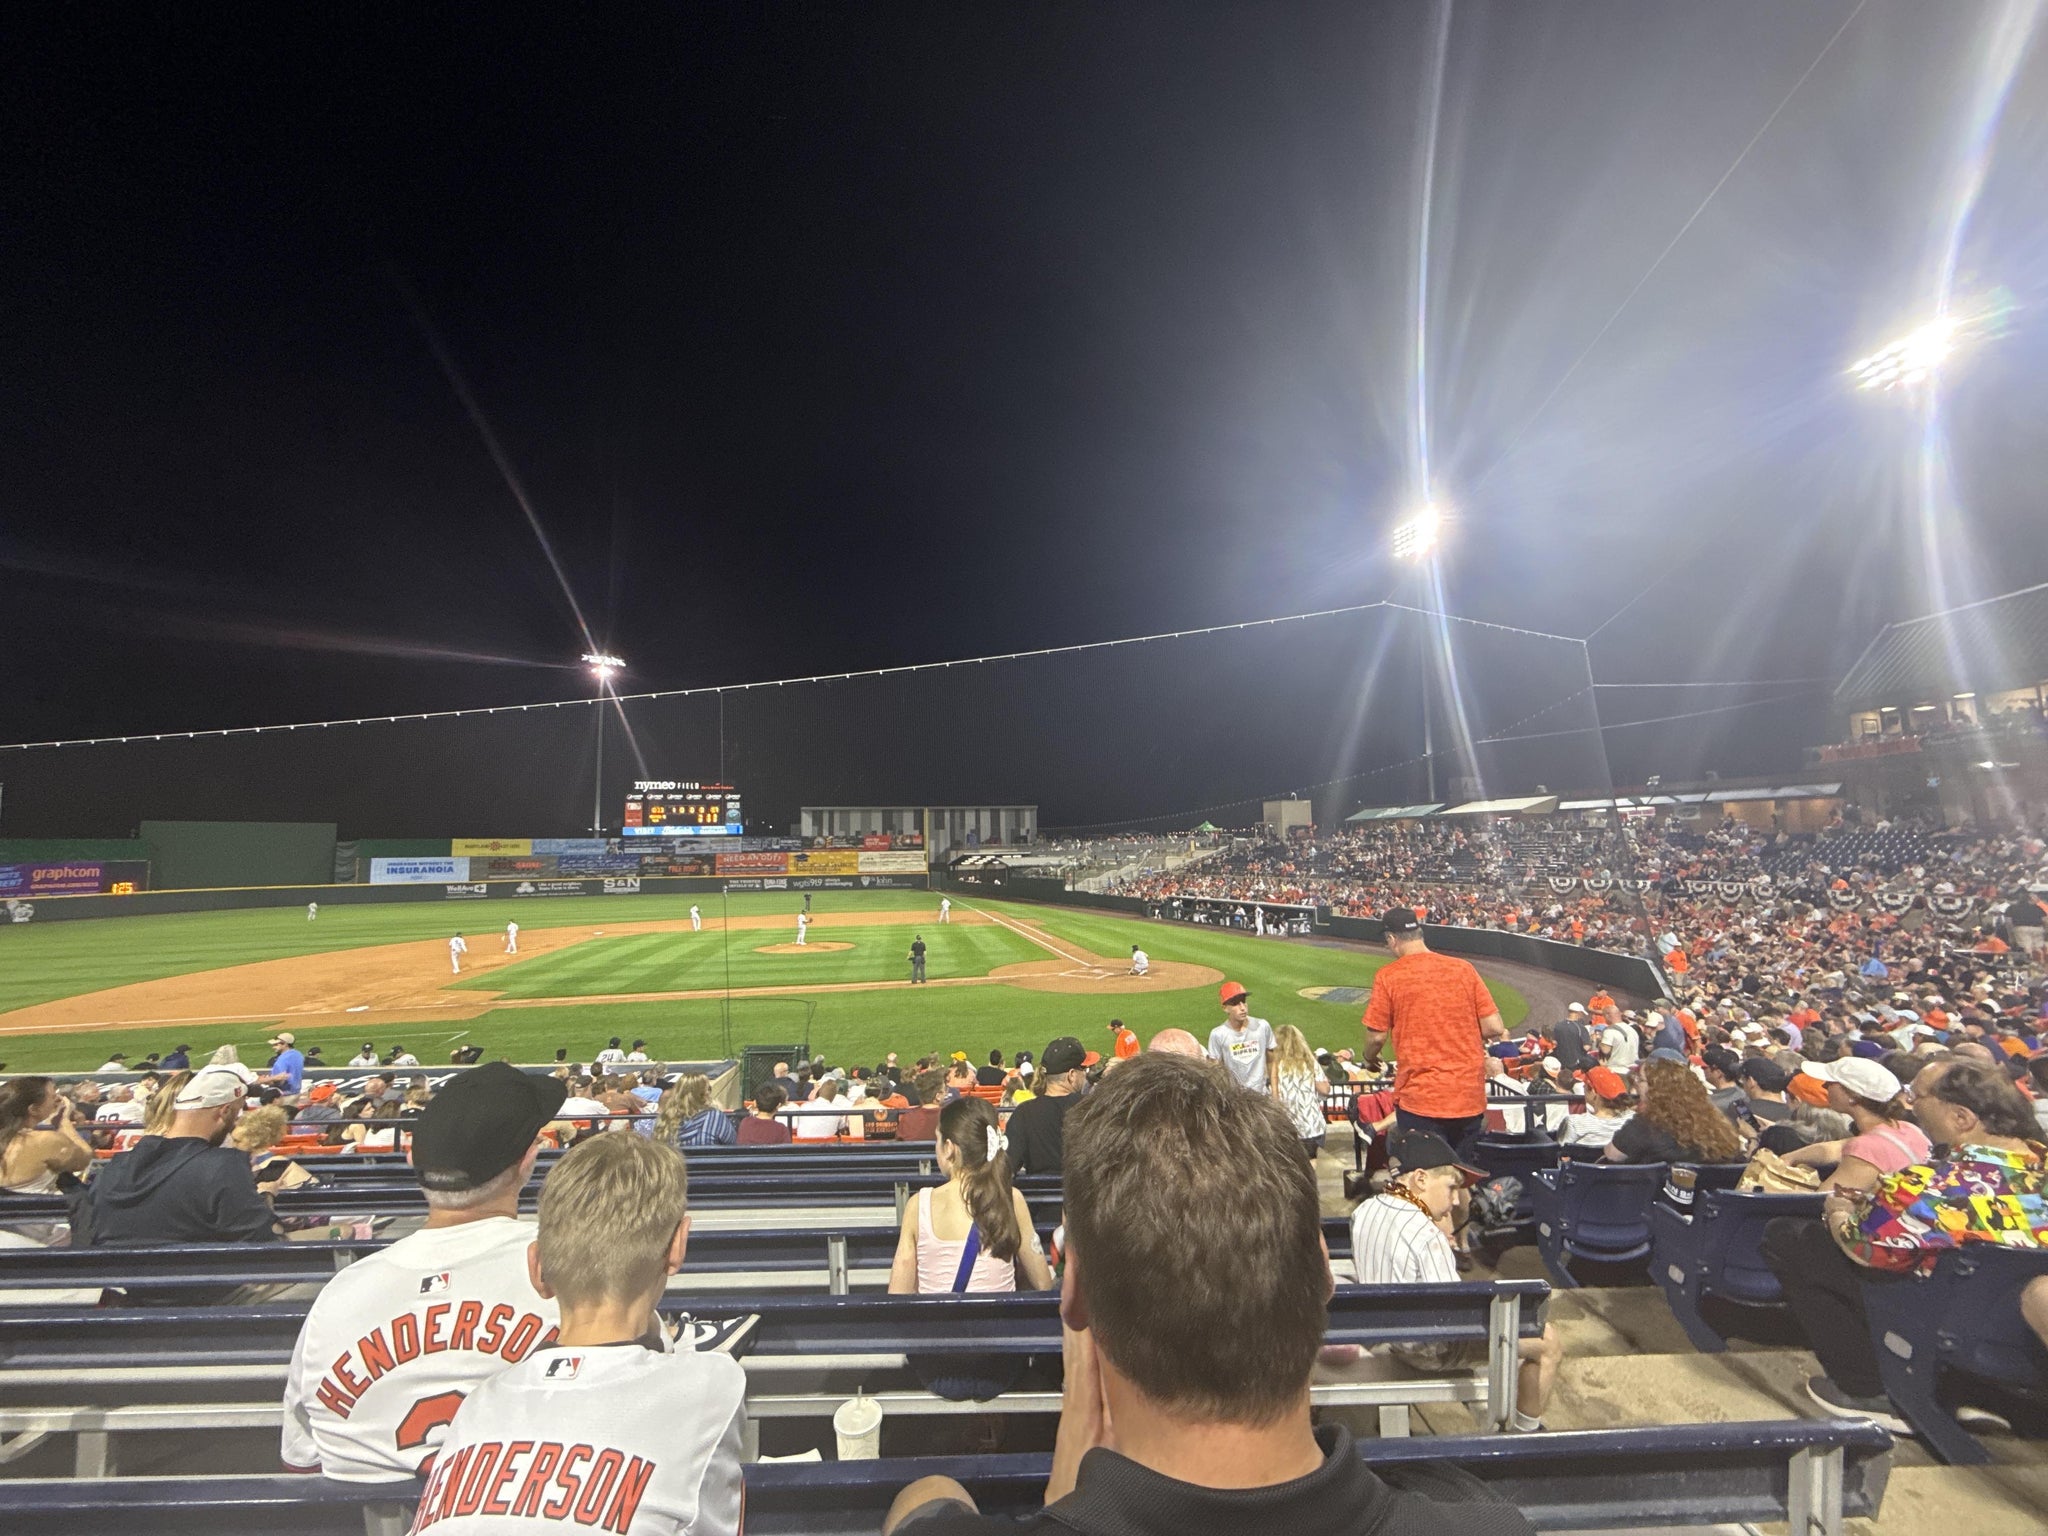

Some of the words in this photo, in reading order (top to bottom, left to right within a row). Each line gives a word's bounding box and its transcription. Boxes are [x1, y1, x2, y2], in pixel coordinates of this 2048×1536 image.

[634, 781, 676, 793] nymeo
[677, 782, 700, 790] FIELD
[723, 855, 745, 863] NEED
[32, 866, 100, 882] graphcom
[386, 866, 454, 875] INSURANOIA
